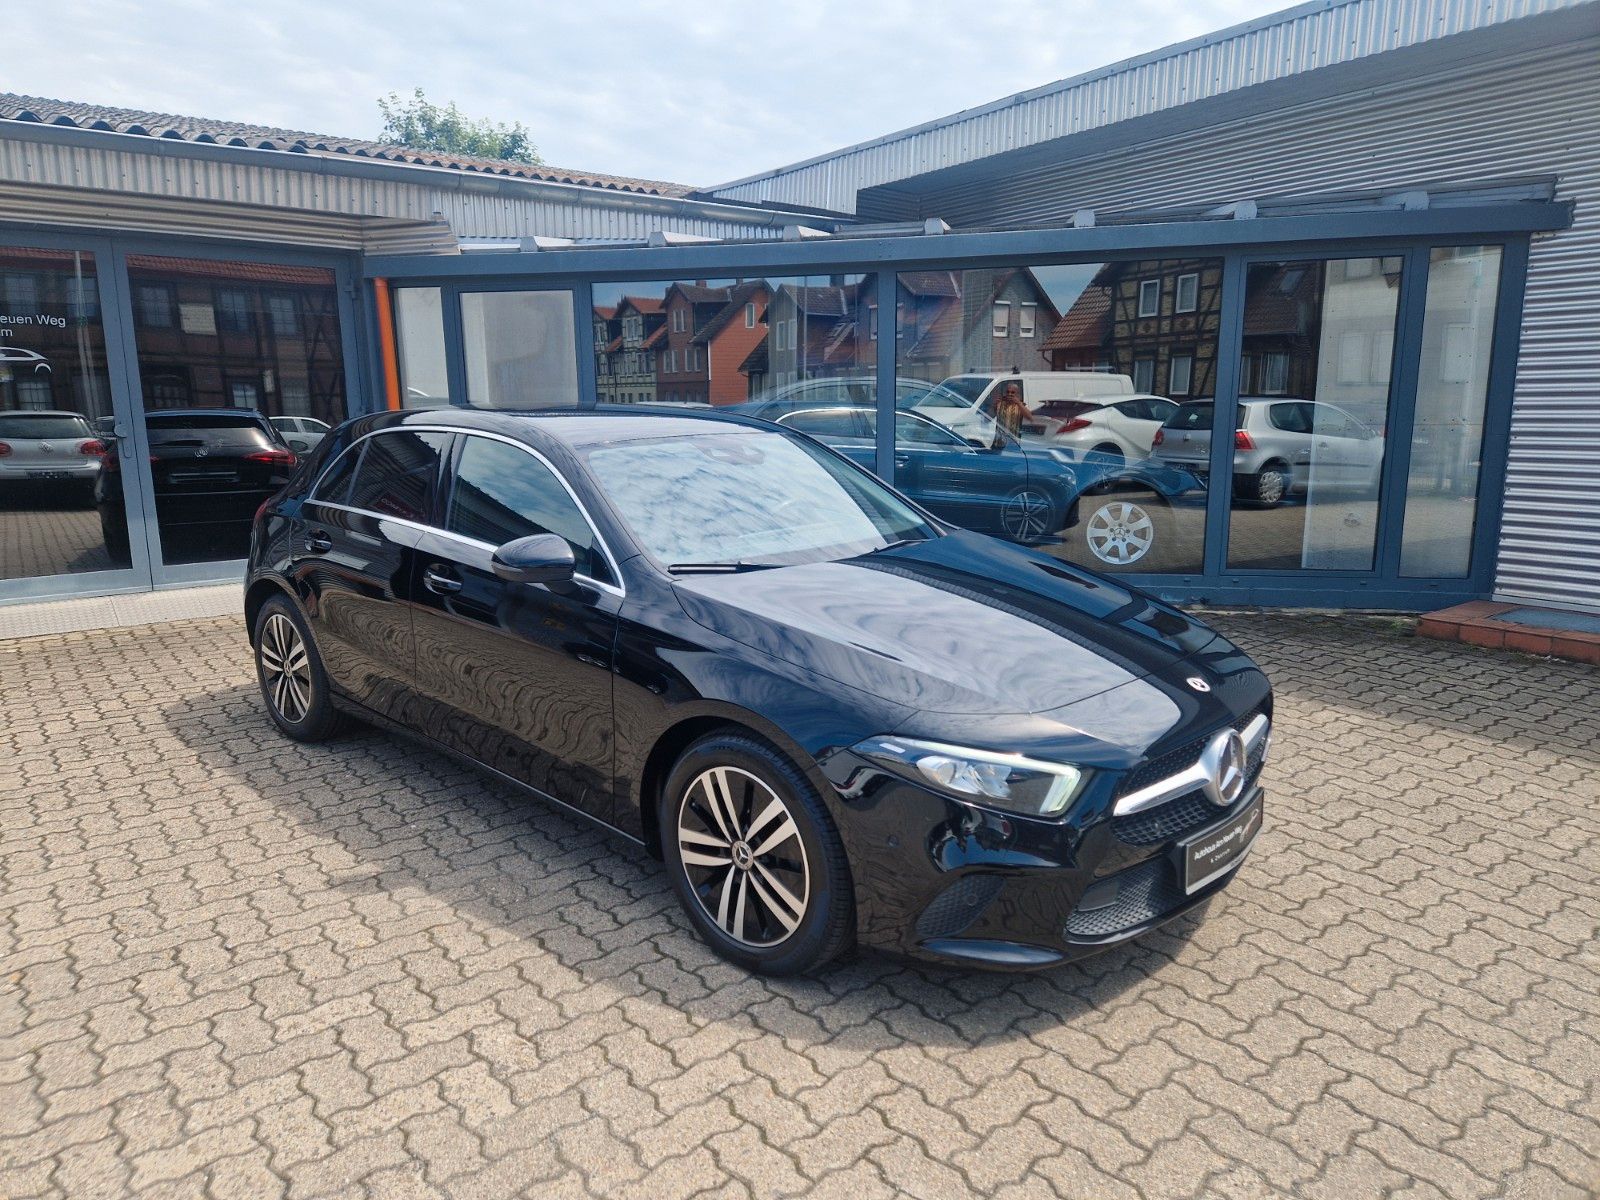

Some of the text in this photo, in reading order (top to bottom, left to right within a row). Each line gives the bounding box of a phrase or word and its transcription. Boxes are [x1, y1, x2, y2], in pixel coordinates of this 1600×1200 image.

[0, 314, 66, 328] euen Weg
[0, 328, 13, 337] m
